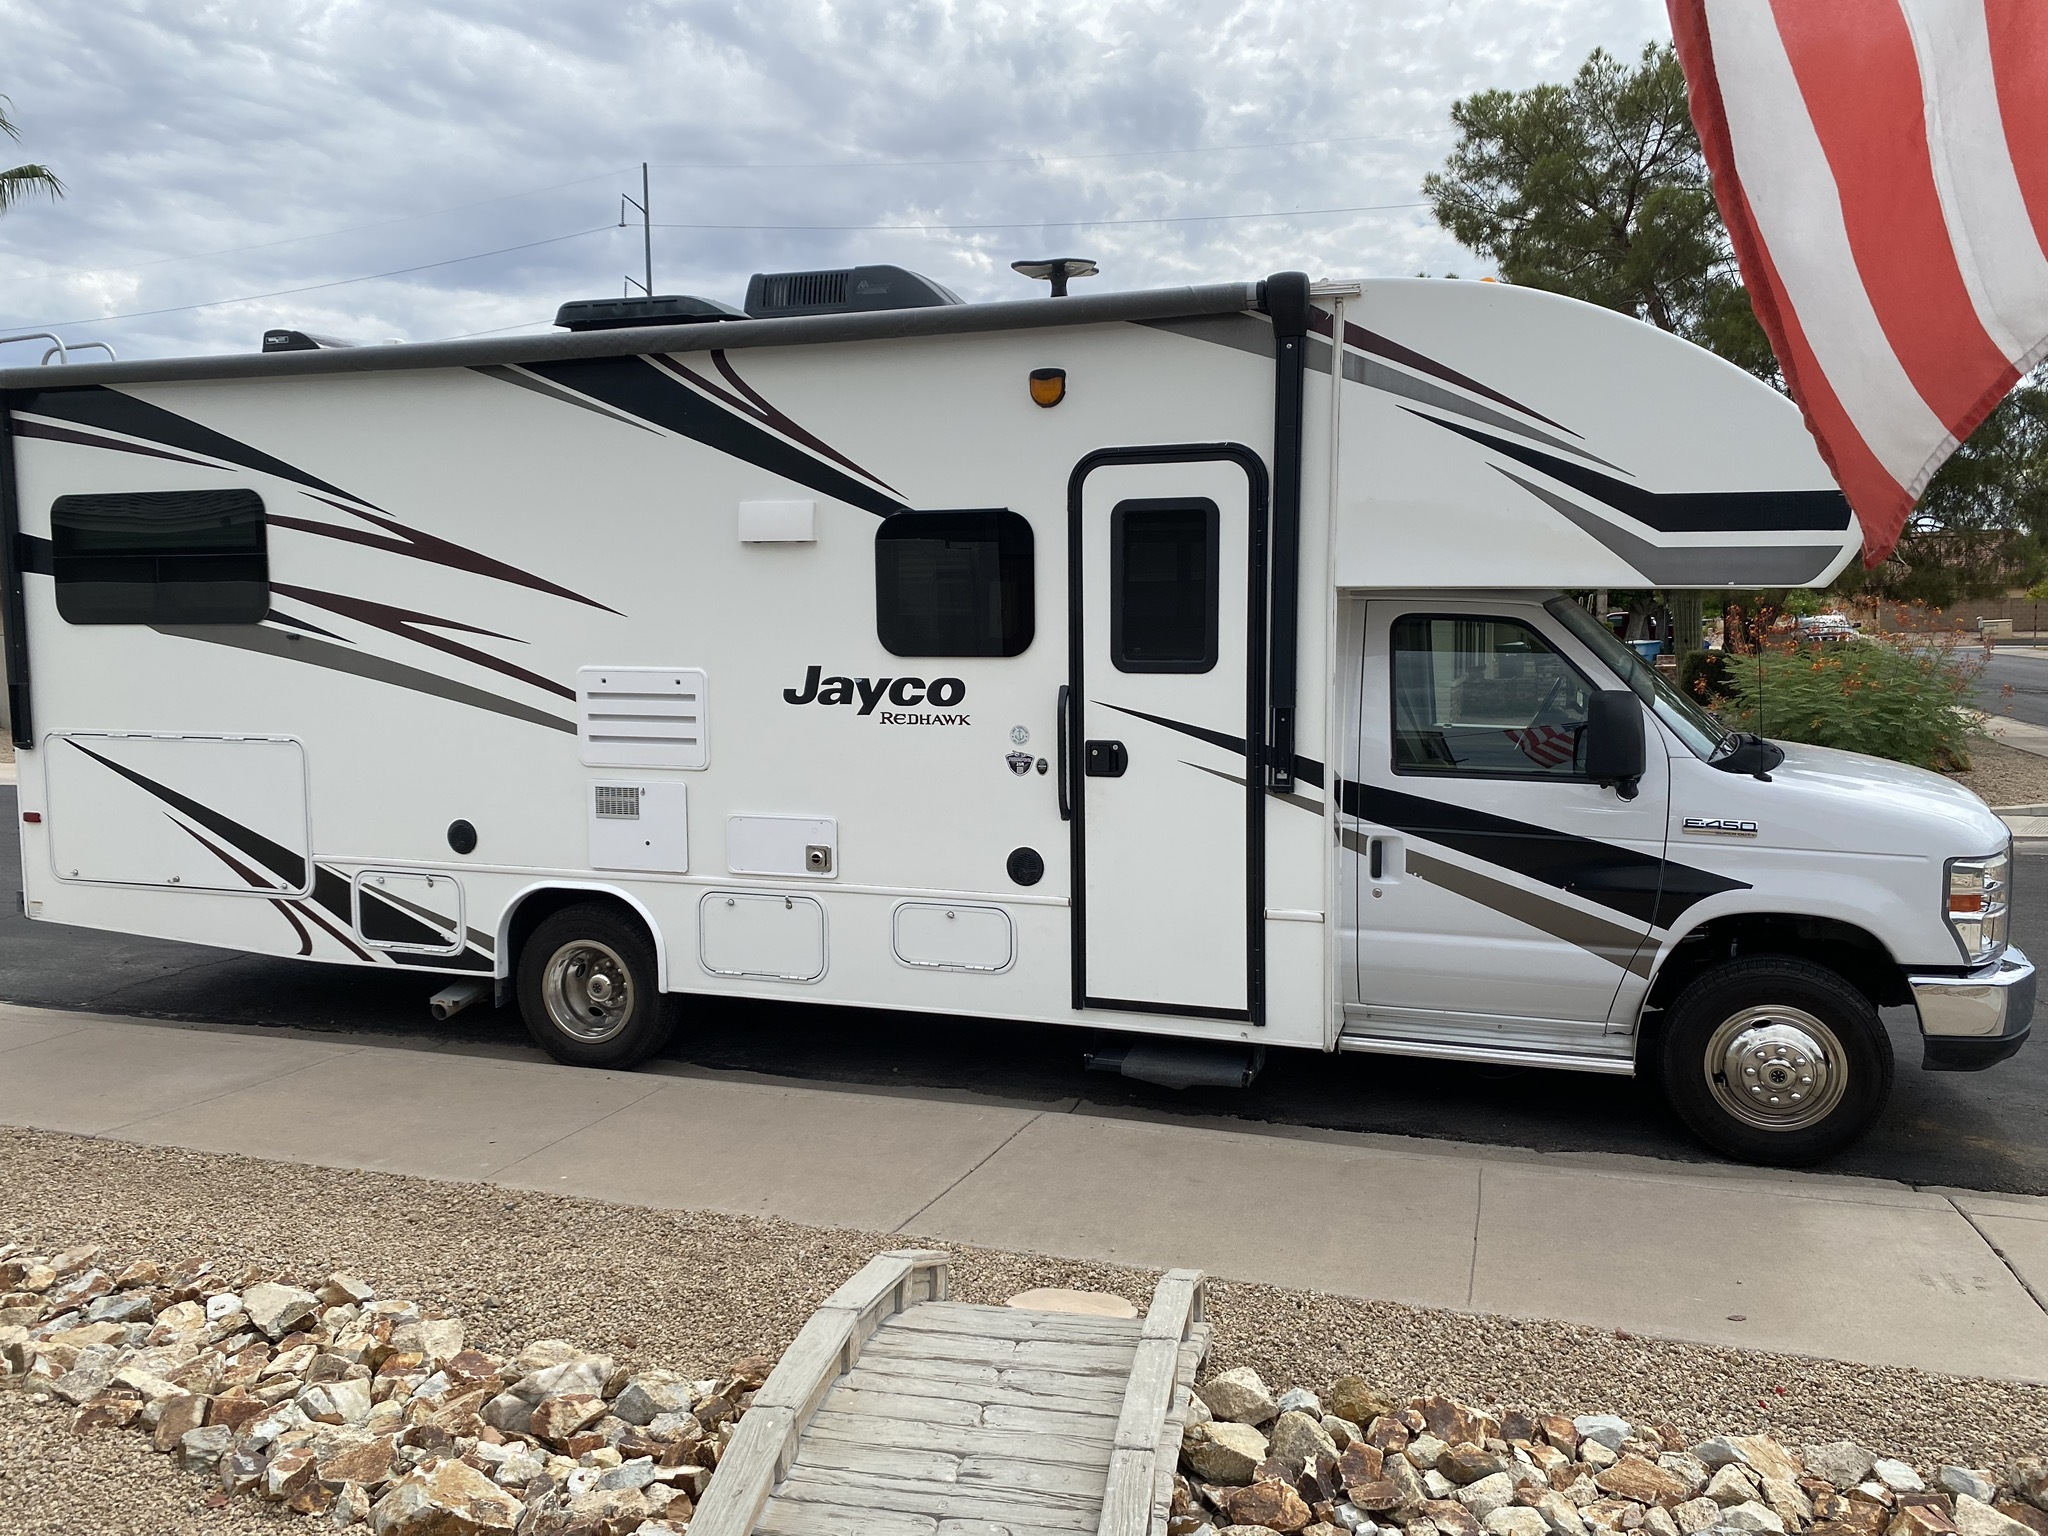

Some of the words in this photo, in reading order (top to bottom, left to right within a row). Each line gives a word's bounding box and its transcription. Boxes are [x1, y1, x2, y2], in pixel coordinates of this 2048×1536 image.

[783, 665, 966, 716] Jayco
[880, 711, 971, 726] REDHAWK
[1684, 818, 1758, 832] E-450
